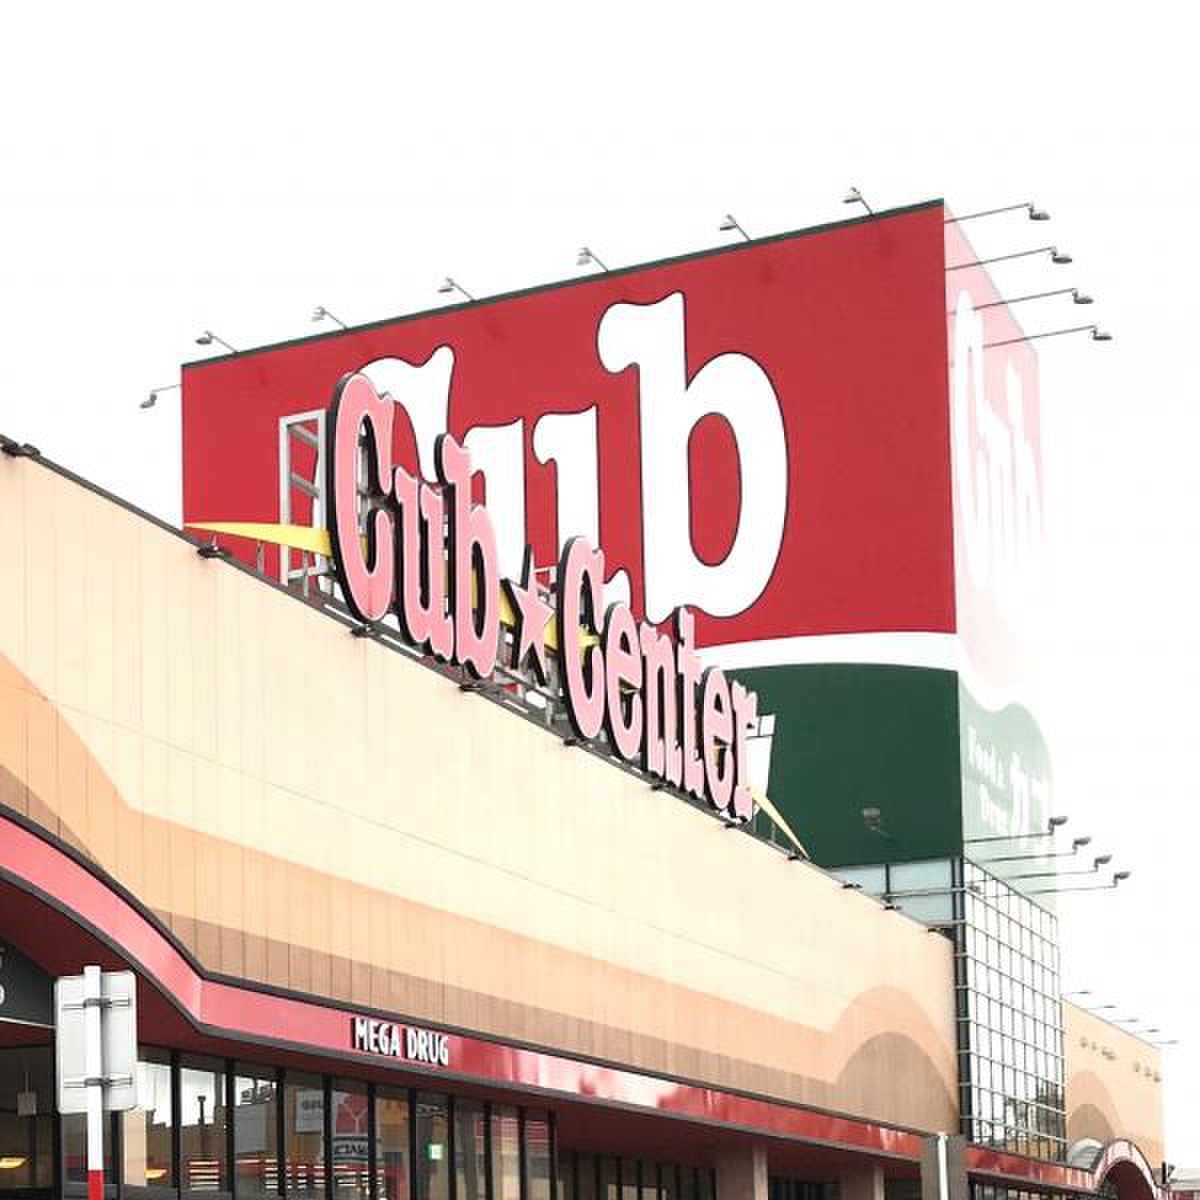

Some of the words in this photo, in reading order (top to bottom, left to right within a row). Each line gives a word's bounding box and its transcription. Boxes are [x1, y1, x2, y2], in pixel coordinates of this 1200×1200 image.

[328, 373, 498, 680] Cub
[559, 537, 758, 823] Center
[354, 1016, 401, 1056] MEGA
[406, 1026, 449, 1067] DRUG
